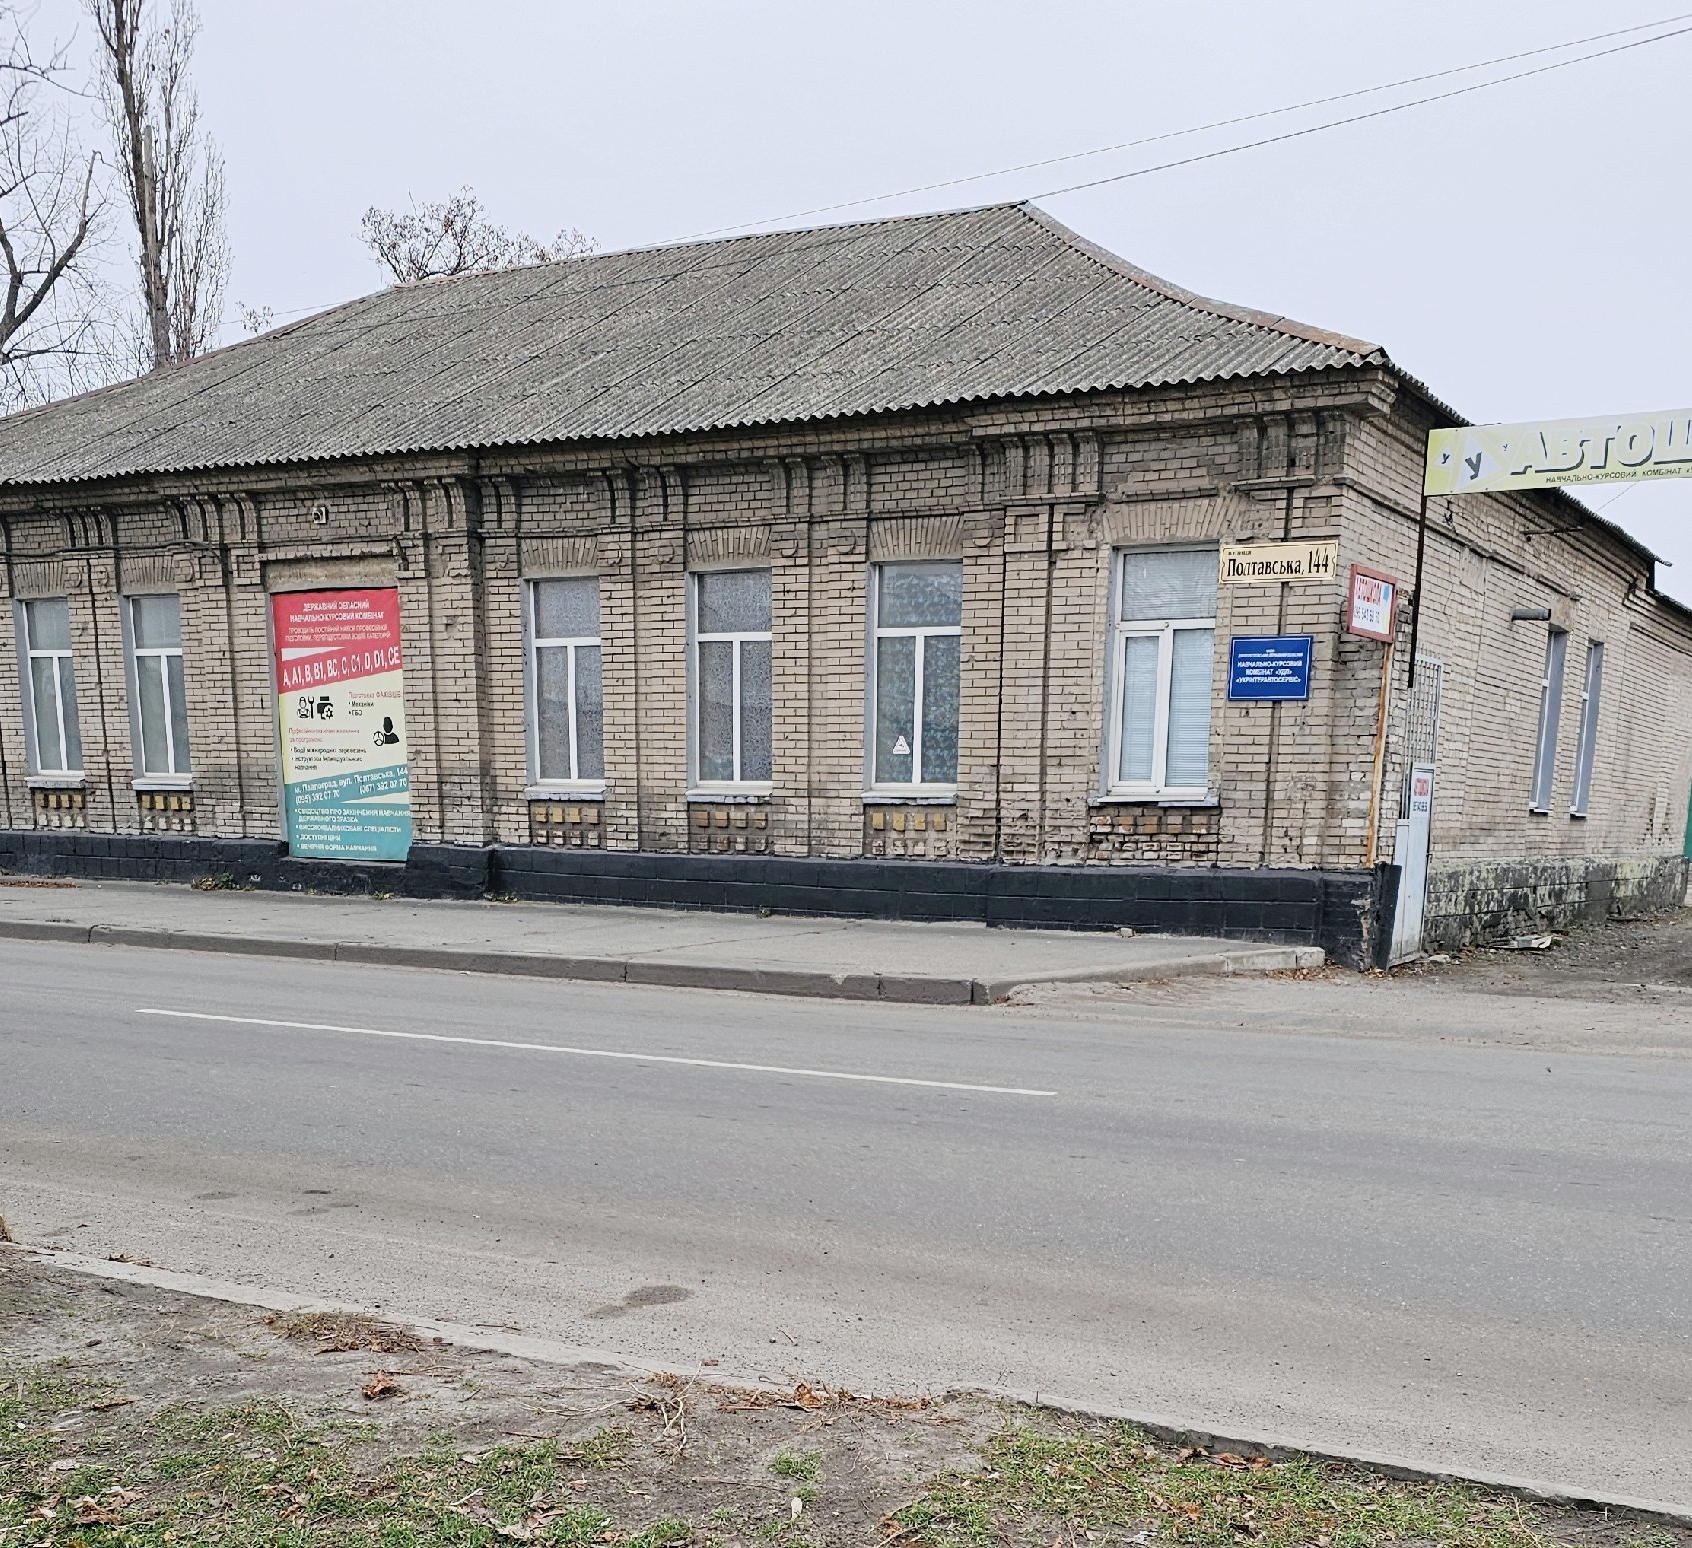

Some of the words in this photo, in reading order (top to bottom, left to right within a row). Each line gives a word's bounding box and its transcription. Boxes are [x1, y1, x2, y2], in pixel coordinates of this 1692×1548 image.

[1227, 558, 1304, 577] Полтавська,
[1308, 547, 1329, 573] 144
[313, 661, 326, 682] B1,
[374, 649, 388, 669] D1,
[388, 646, 400, 666] CE
[396, 767, 408, 776] 144
